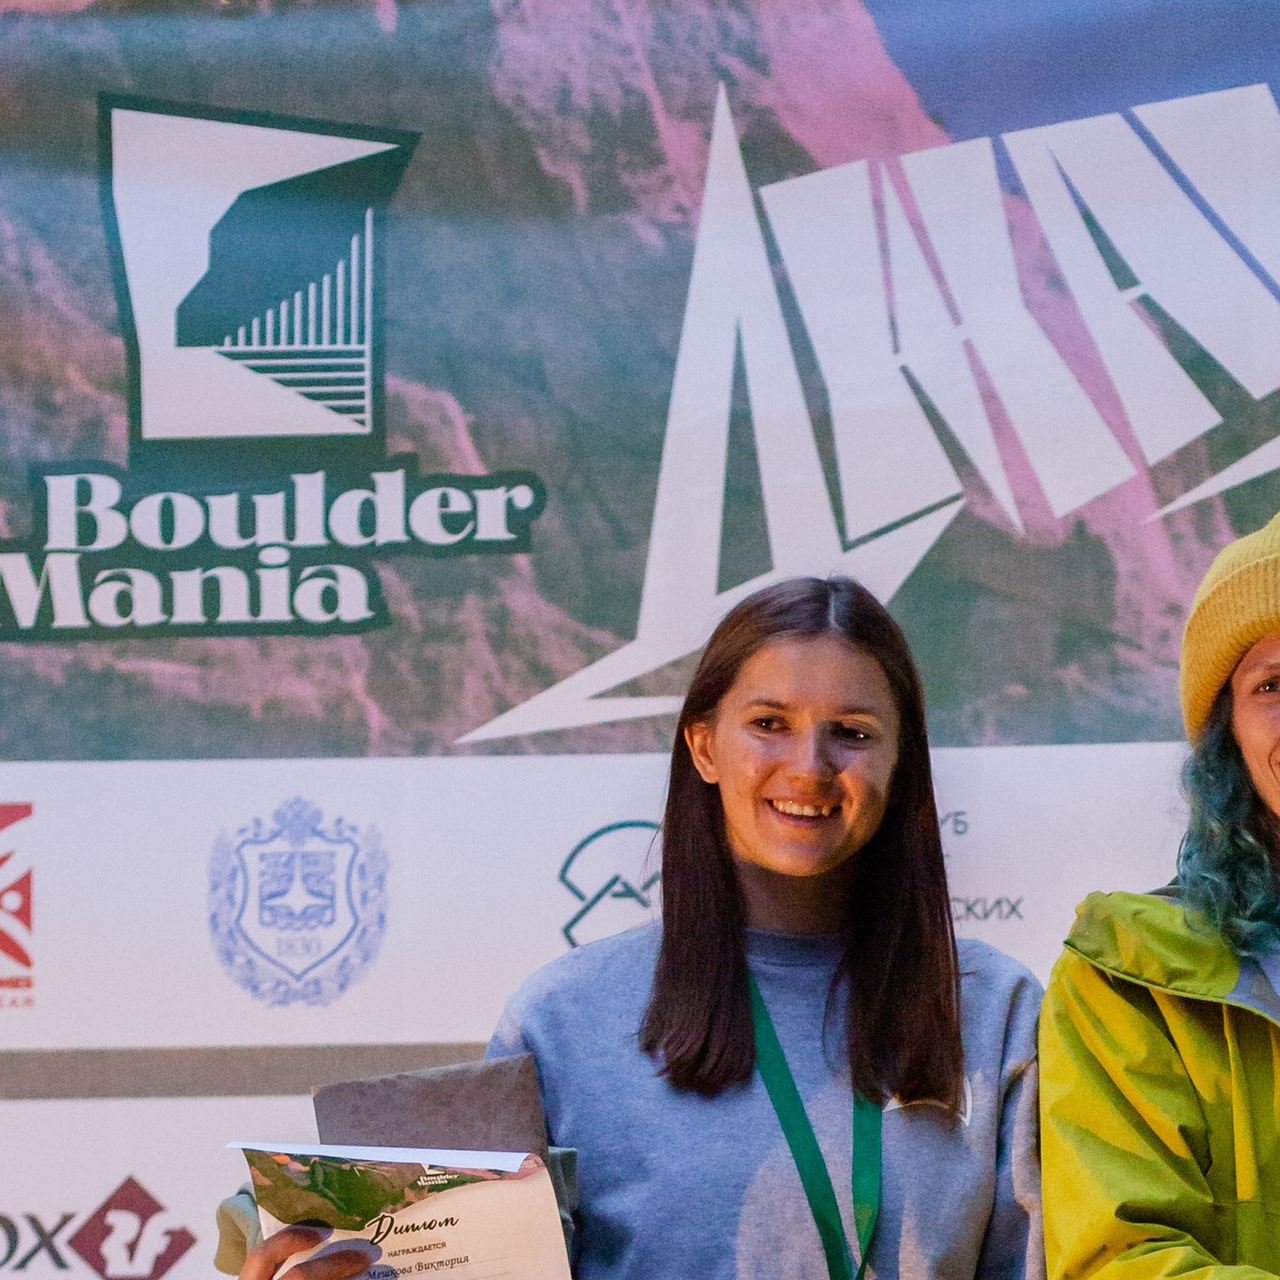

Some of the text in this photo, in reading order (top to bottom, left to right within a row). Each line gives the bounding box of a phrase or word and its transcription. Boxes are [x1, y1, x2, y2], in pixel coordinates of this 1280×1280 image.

[43, 469, 536, 551] Boulder
[0, 546, 376, 631] Mania
[366, 1212, 460, 1246] Диплом
[387, 1241, 447, 1258] НАГРАЖДАЕТСЯ
[414, 1254, 470, 1273] Виктория
